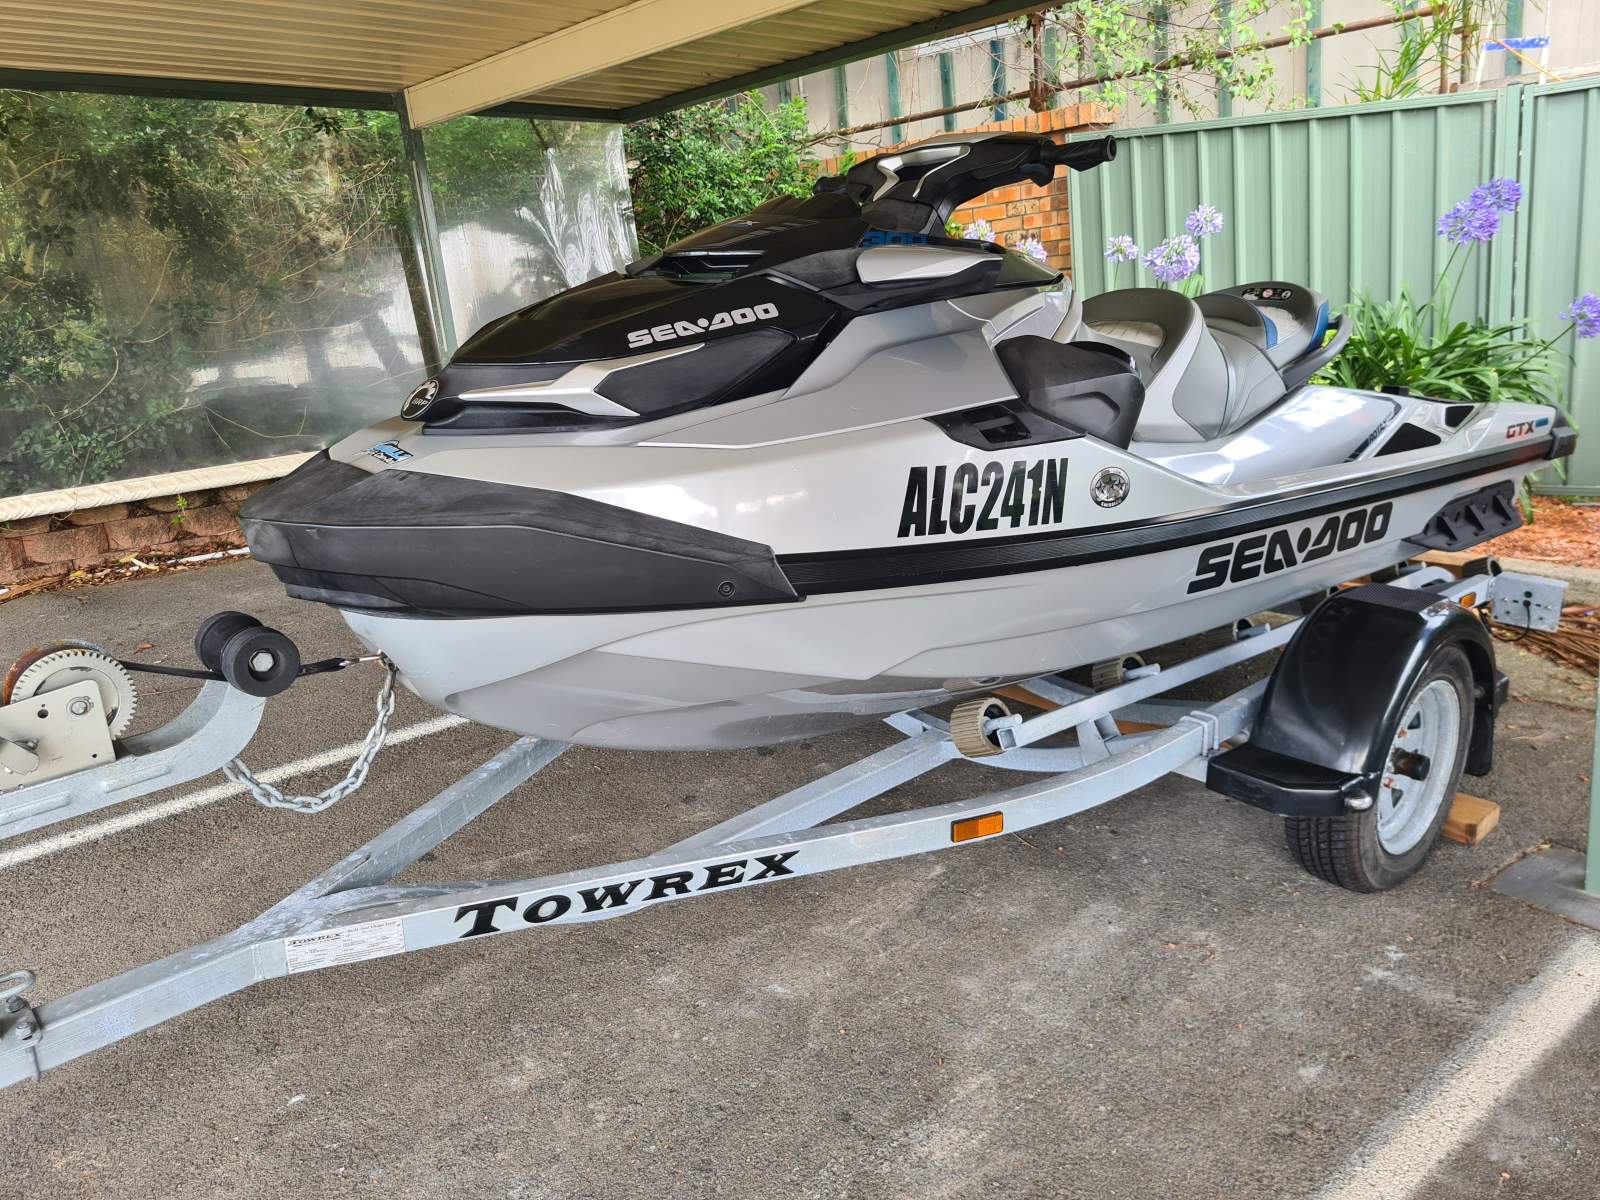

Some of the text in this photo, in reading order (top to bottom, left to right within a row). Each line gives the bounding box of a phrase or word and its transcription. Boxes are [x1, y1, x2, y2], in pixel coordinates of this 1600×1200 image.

[1506, 420, 1534, 439] GTX
[897, 457, 1069, 538] ALC241N
[454, 850, 800, 939] TOWREX
